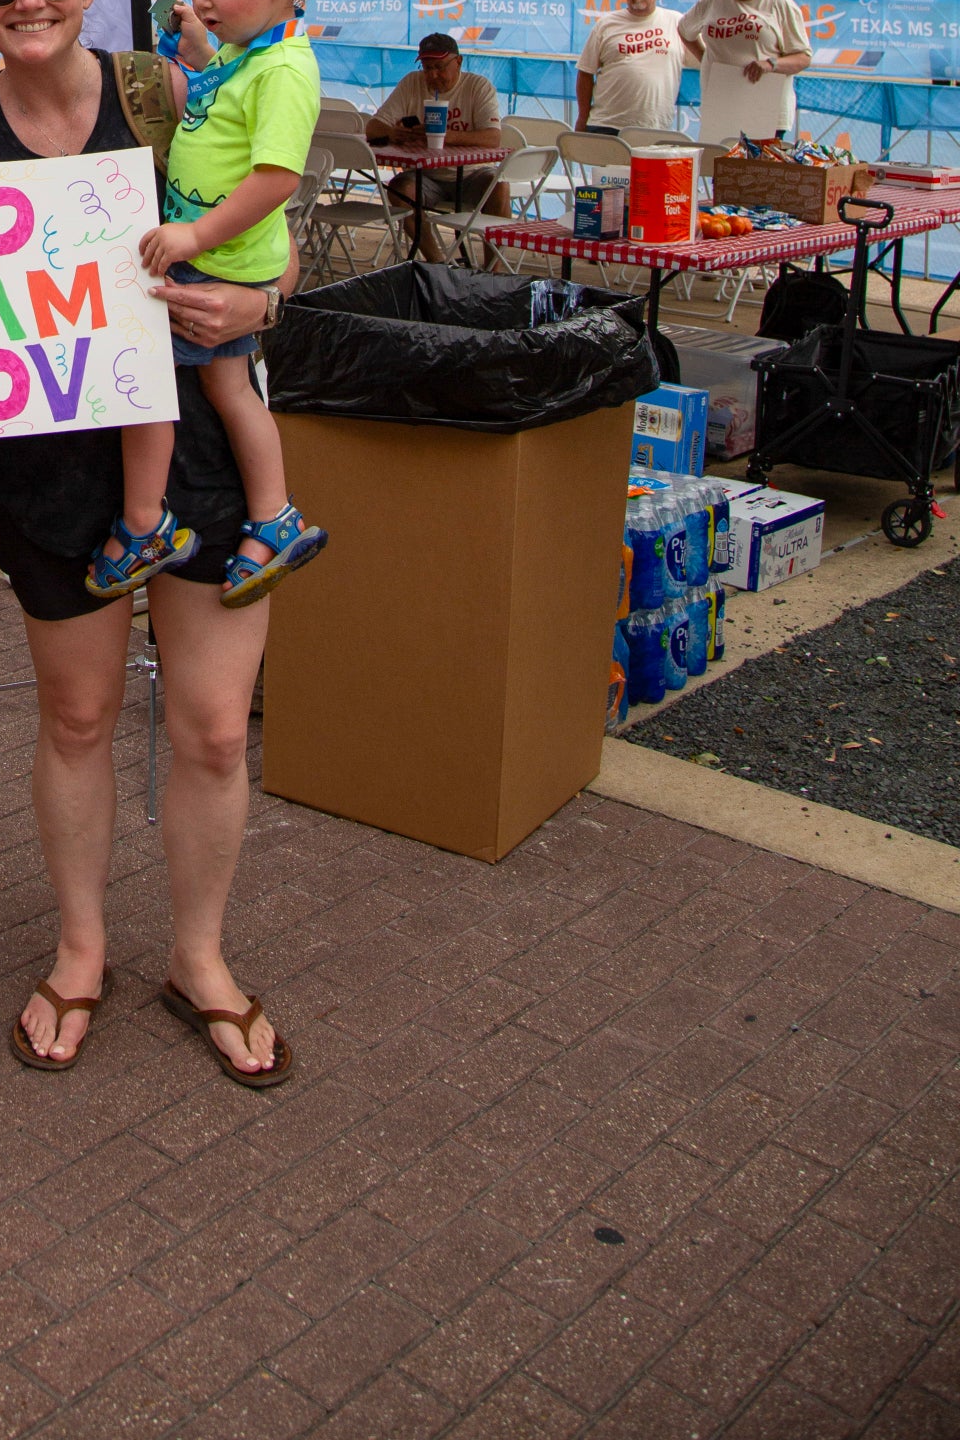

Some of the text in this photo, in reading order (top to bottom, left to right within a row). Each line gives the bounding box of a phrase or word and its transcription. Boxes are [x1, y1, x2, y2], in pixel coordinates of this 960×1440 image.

[316, 0, 357, 13] TEXAS
[380, 0, 402, 12] 150
[474, 0, 565, 17] TEXAS MS 150
[716, 13, 758, 26] GOOD
[707, 23, 763, 40] ENERGY
[850, 18, 960, 38] TEXAS MS 15
[624, 28, 663, 43] GOOD
[618, 38, 671, 55] ENERGY
[190, 75, 220, 93] MS 150
[607, 175, 630, 186] LIQUID
[576, 191, 598, 199] Advil
[664, 193, 690, 204] Essuie-
[664, 204, 681, 216] Tout
[636, 405, 649, 432] Modelo
[671, 537, 685, 550] Pu
[778, 536, 808, 558] ULTRA
[676, 627, 688, 640] Pu
